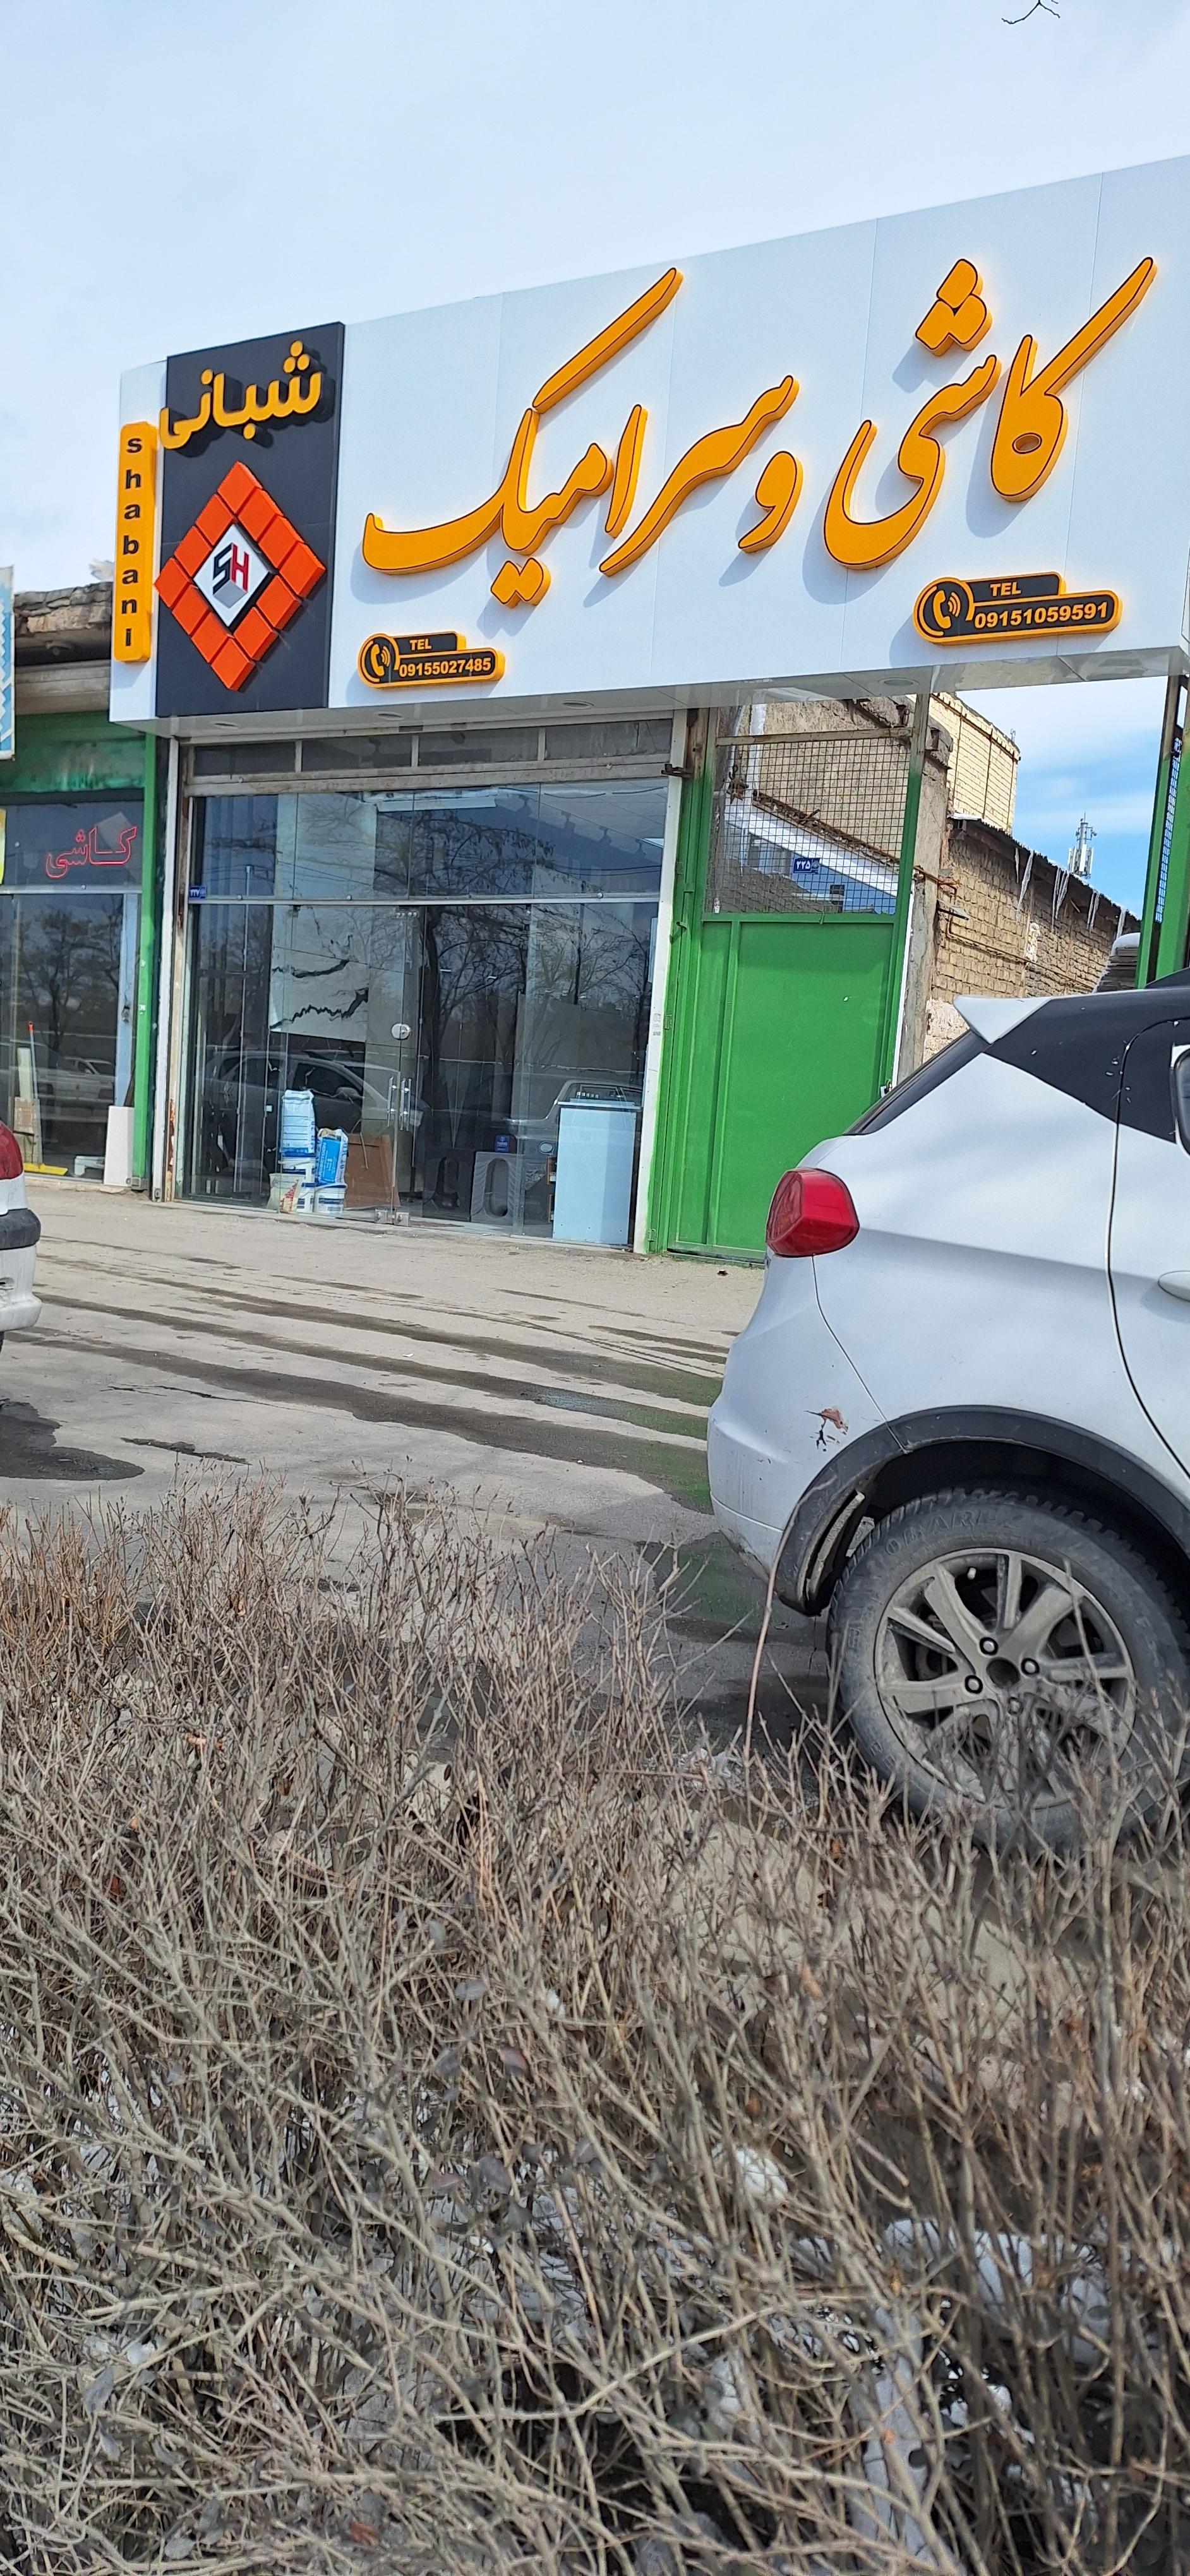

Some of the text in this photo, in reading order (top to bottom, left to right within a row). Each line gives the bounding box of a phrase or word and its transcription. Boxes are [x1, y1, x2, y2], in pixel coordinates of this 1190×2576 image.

[159, 340, 323, 450] شبانی
[362, 256, 1158, 609] کاشی و سرامیک
[121, 435, 143, 648] shabani
[990, 581, 1022, 597] TEL
[974, 601, 1108, 629] 09151059591
[409, 638, 432, 651] TEL
[399, 657, 491, 677] 09155027485
[45, 824, 138, 880] کاشی
